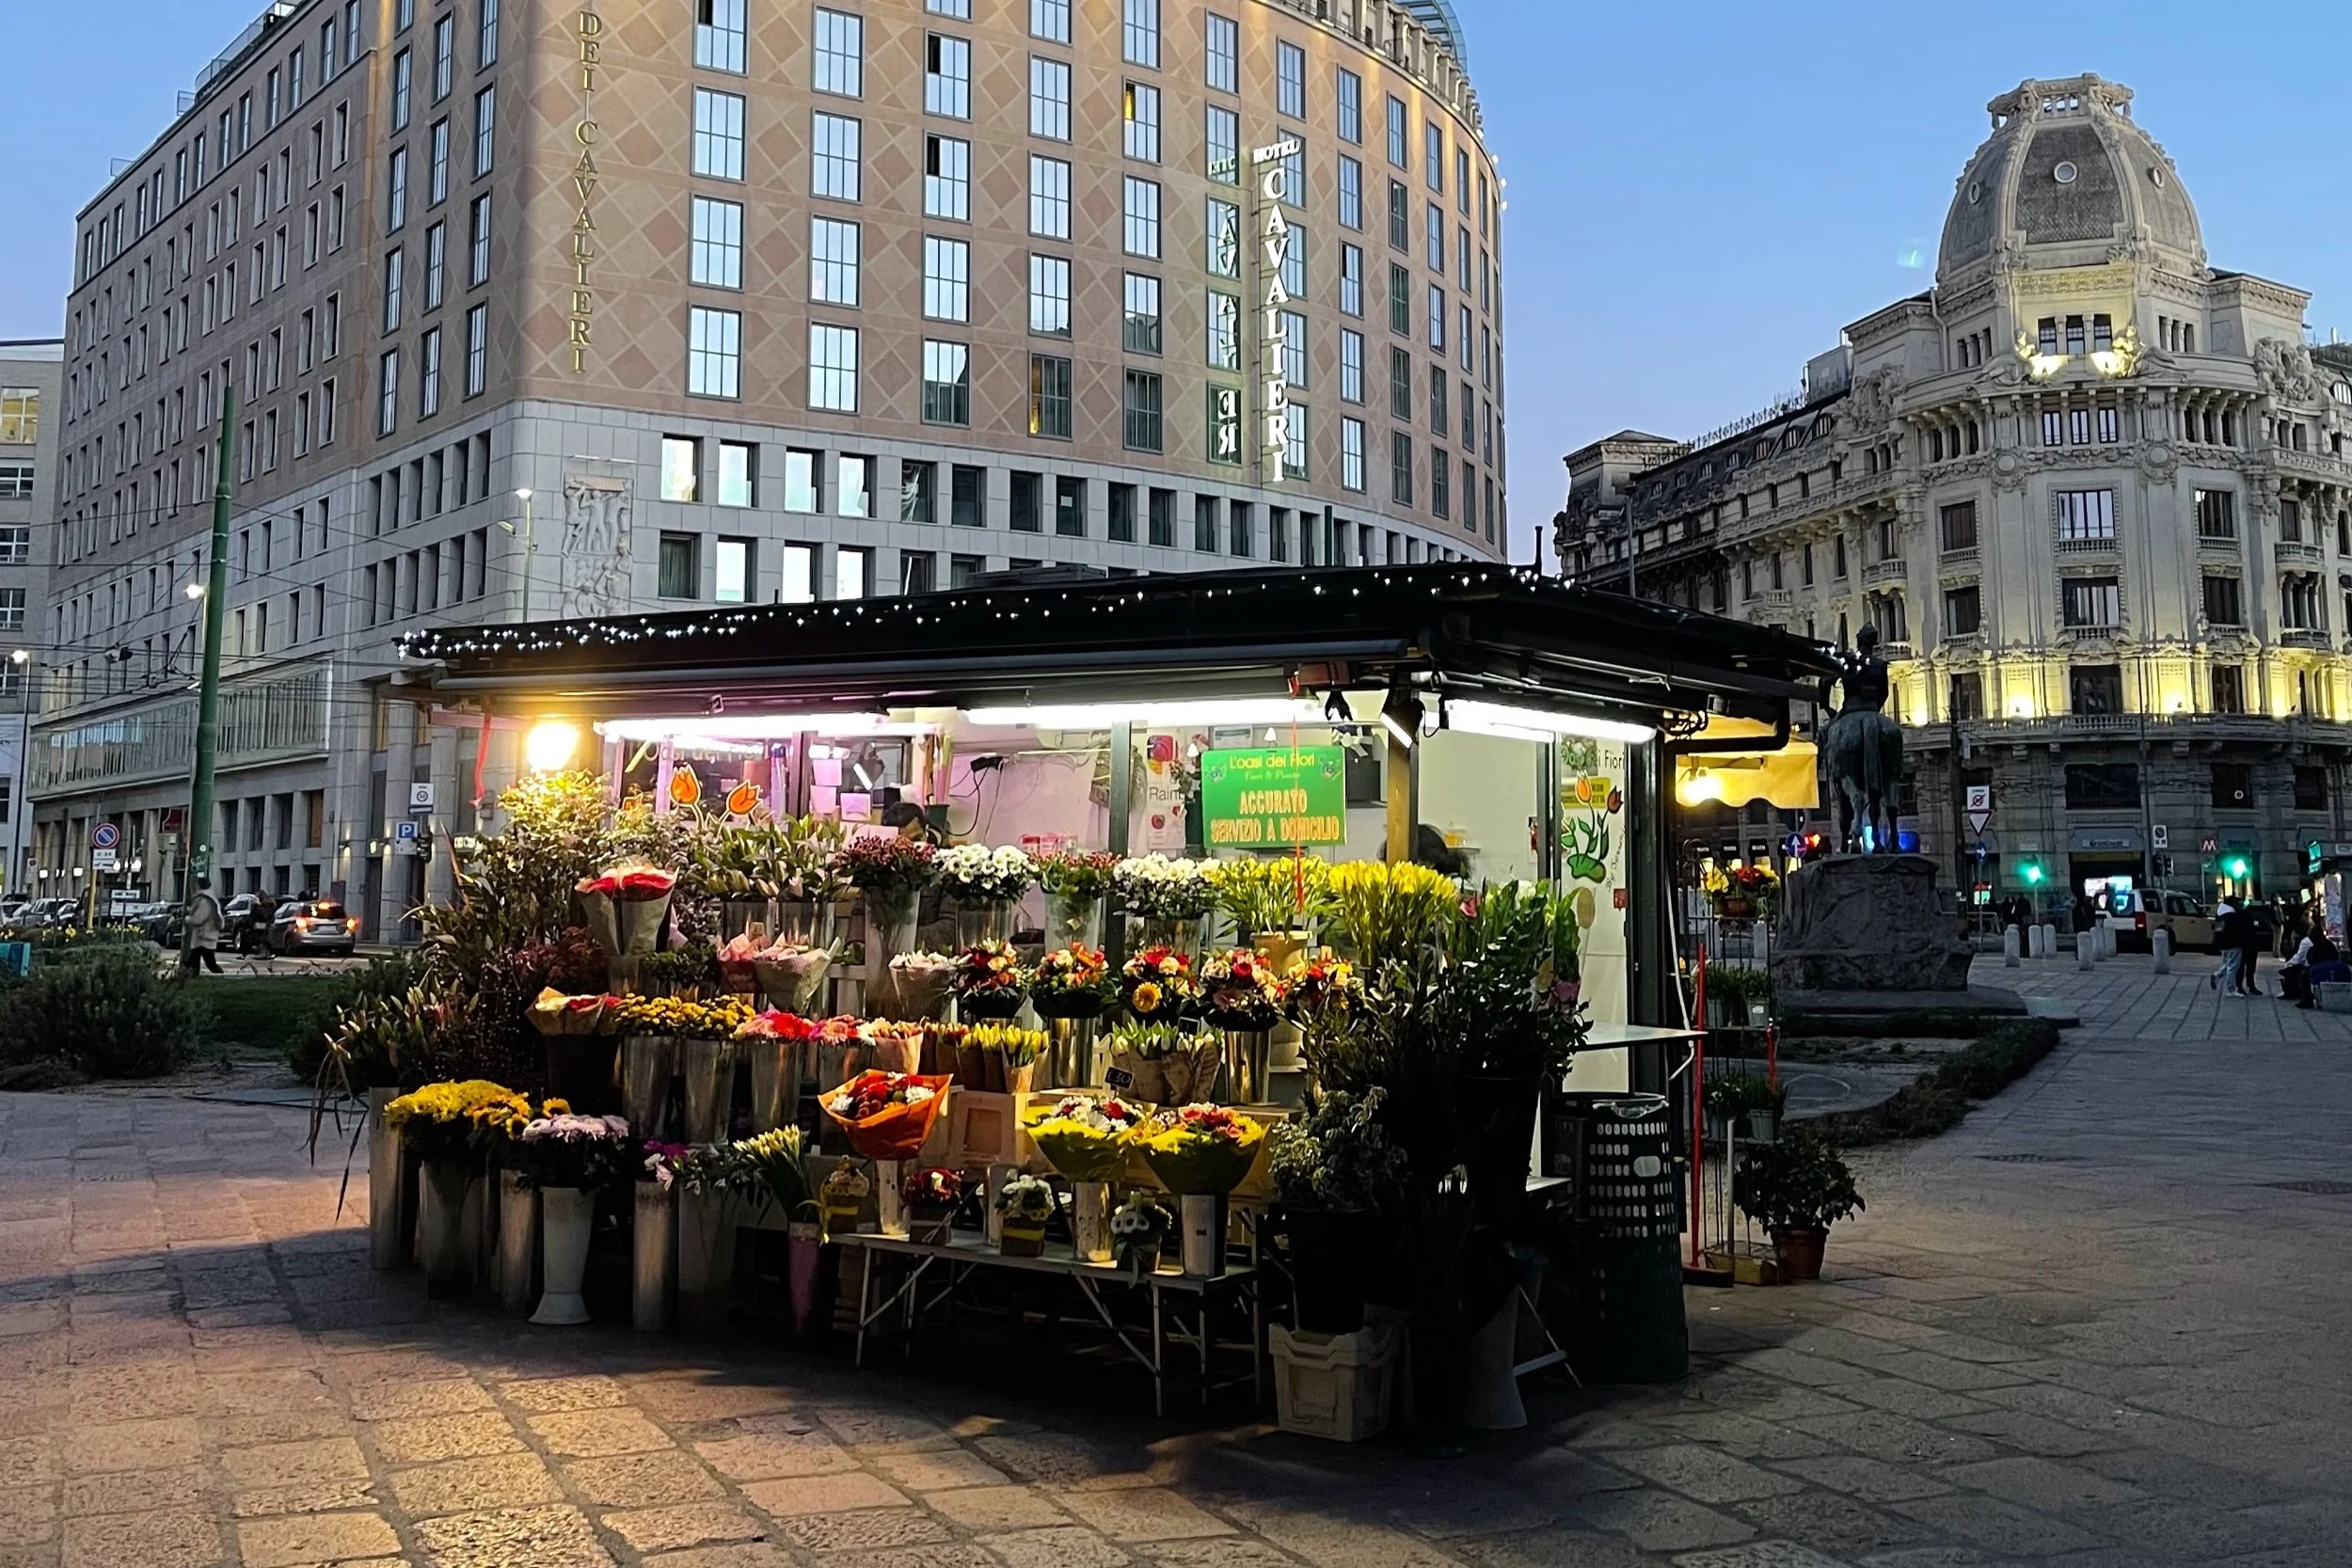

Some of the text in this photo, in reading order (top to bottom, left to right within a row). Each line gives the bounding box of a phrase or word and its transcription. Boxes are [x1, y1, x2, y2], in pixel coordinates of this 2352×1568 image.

[1253, 139, 1300, 164] HOTEL
[569, 10, 602, 374] DEI CAVALIERI
[1263, 167, 1291, 483] CAVALIERI
[1265, 753, 1286, 768] dei
[1290, 752, 1315, 767] Fiori
[1149, 786, 1184, 801] Rain
[1239, 788, 1308, 816] ACCURATO
[401, 824, 412, 837] P
[1210, 815, 1341, 844] SERVIZIO A DOMICILIO
[2202, 839, 2217, 851] M
